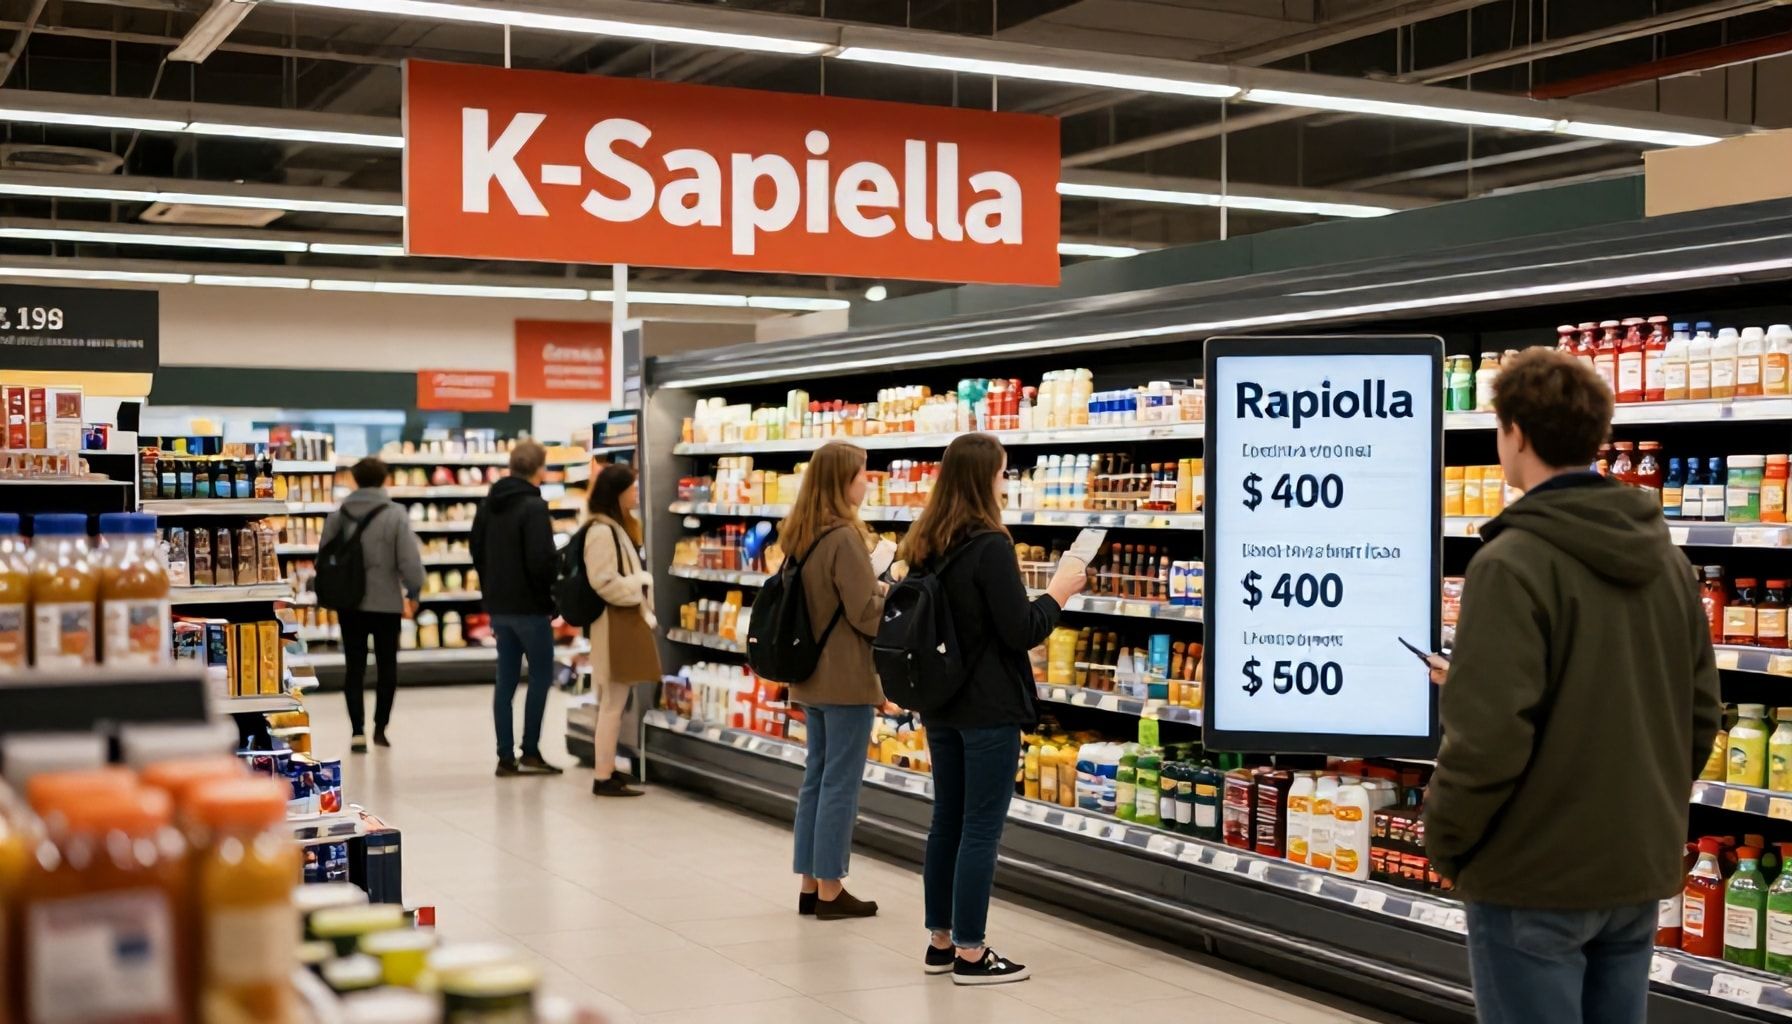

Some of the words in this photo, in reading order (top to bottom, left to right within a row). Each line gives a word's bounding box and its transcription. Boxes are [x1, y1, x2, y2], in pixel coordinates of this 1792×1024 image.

[461, 106, 1023, 256] K-Sapiella
[1236, 379, 1414, 429] Rapiolla
[1271, 473, 1344, 509] 400
[1271, 572, 1344, 608] 400
